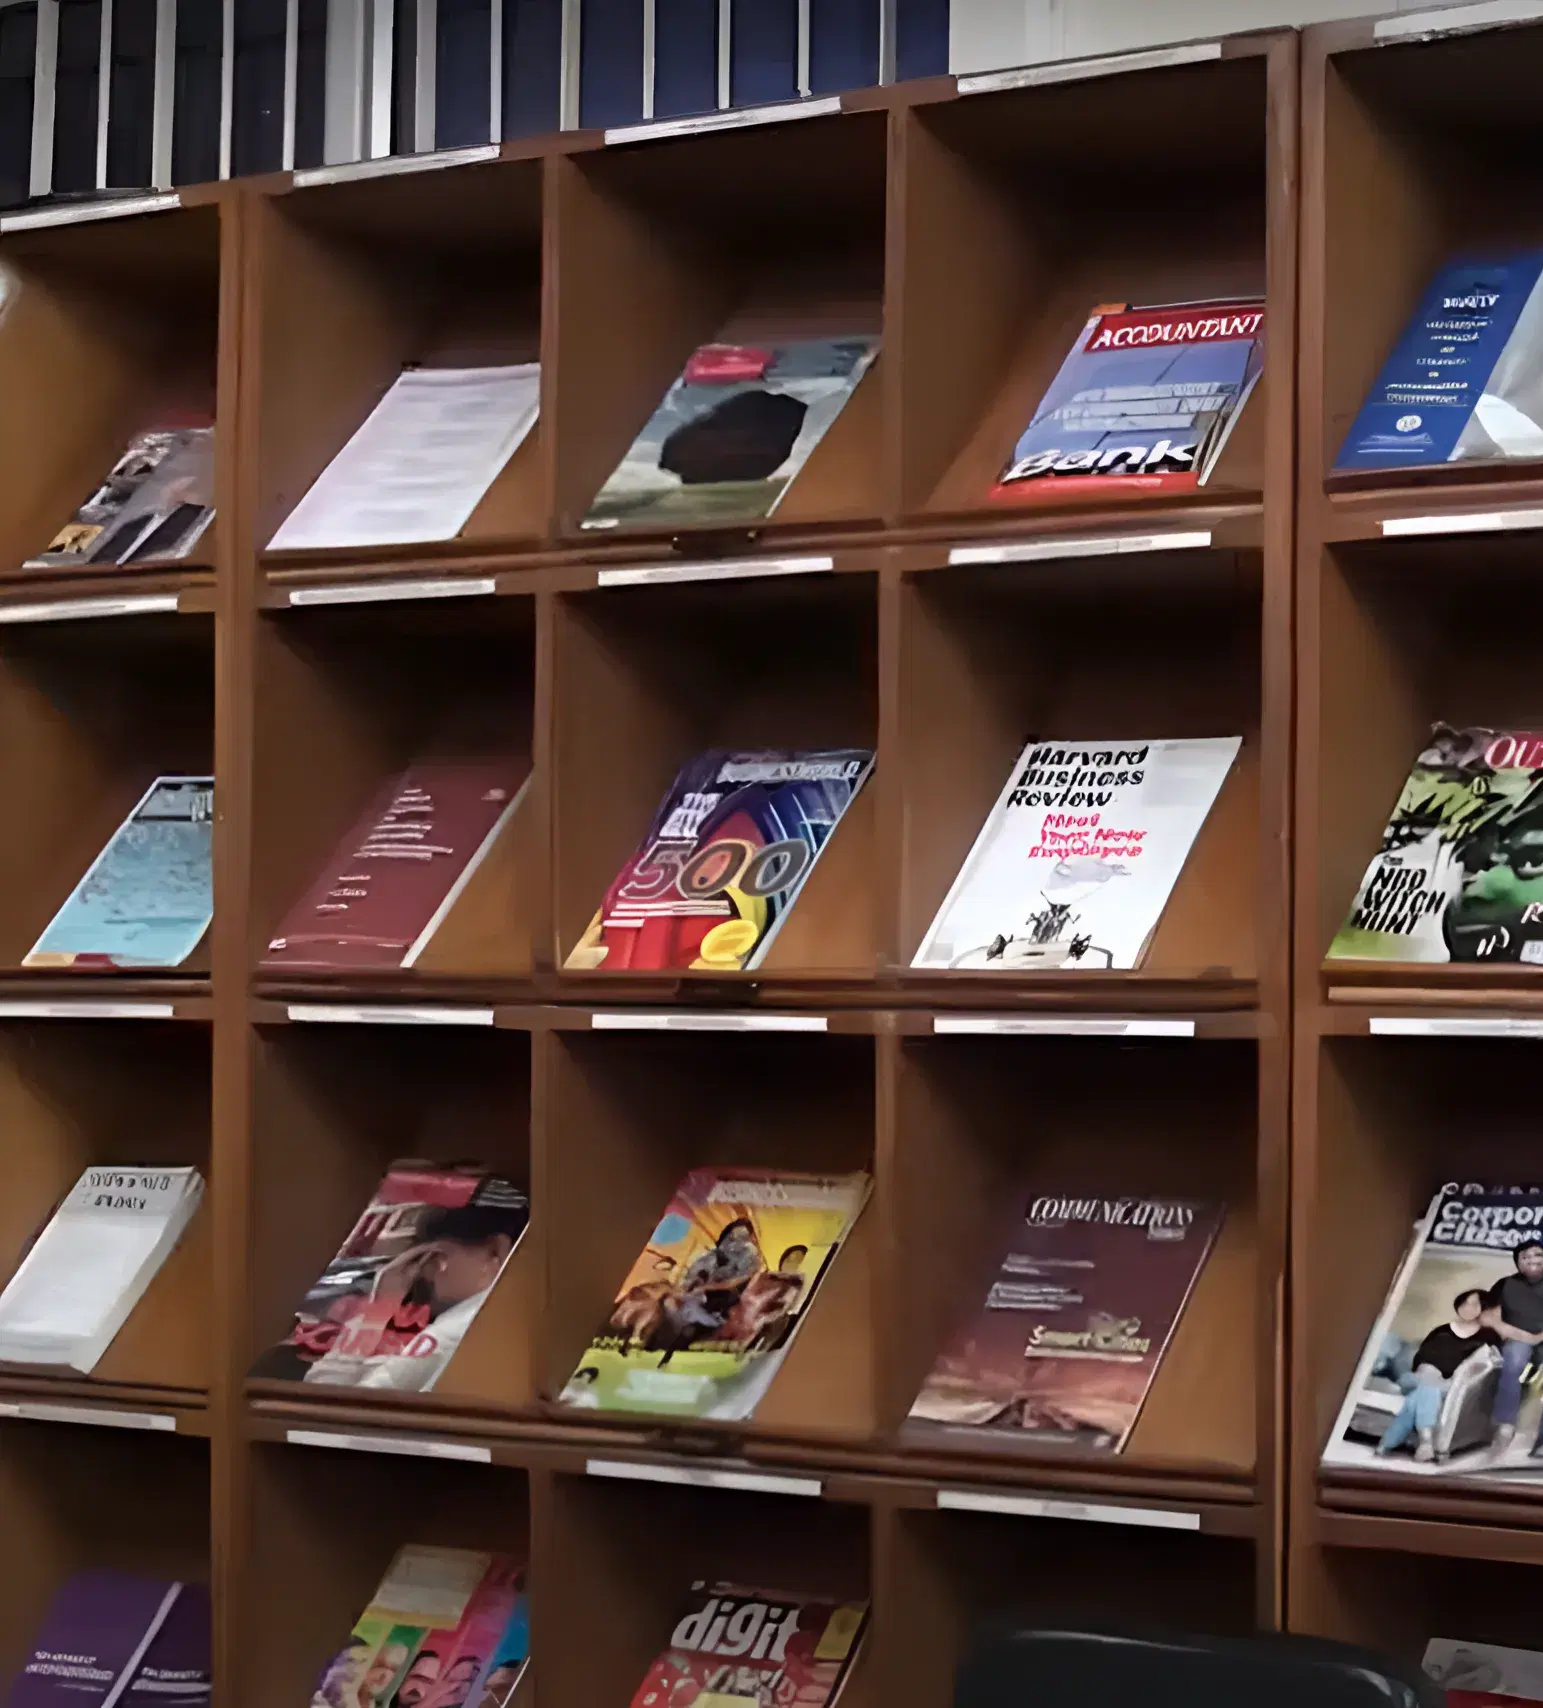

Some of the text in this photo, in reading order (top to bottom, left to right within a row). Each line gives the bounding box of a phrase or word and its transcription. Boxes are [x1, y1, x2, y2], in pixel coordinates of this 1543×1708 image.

[1027, 745, 1150, 766] Harvard
[1016, 767, 1145, 787] Business
[1005, 787, 1112, 809] Review
[618, 838, 810, 900] 500
[670, 1599, 800, 1662] digit
